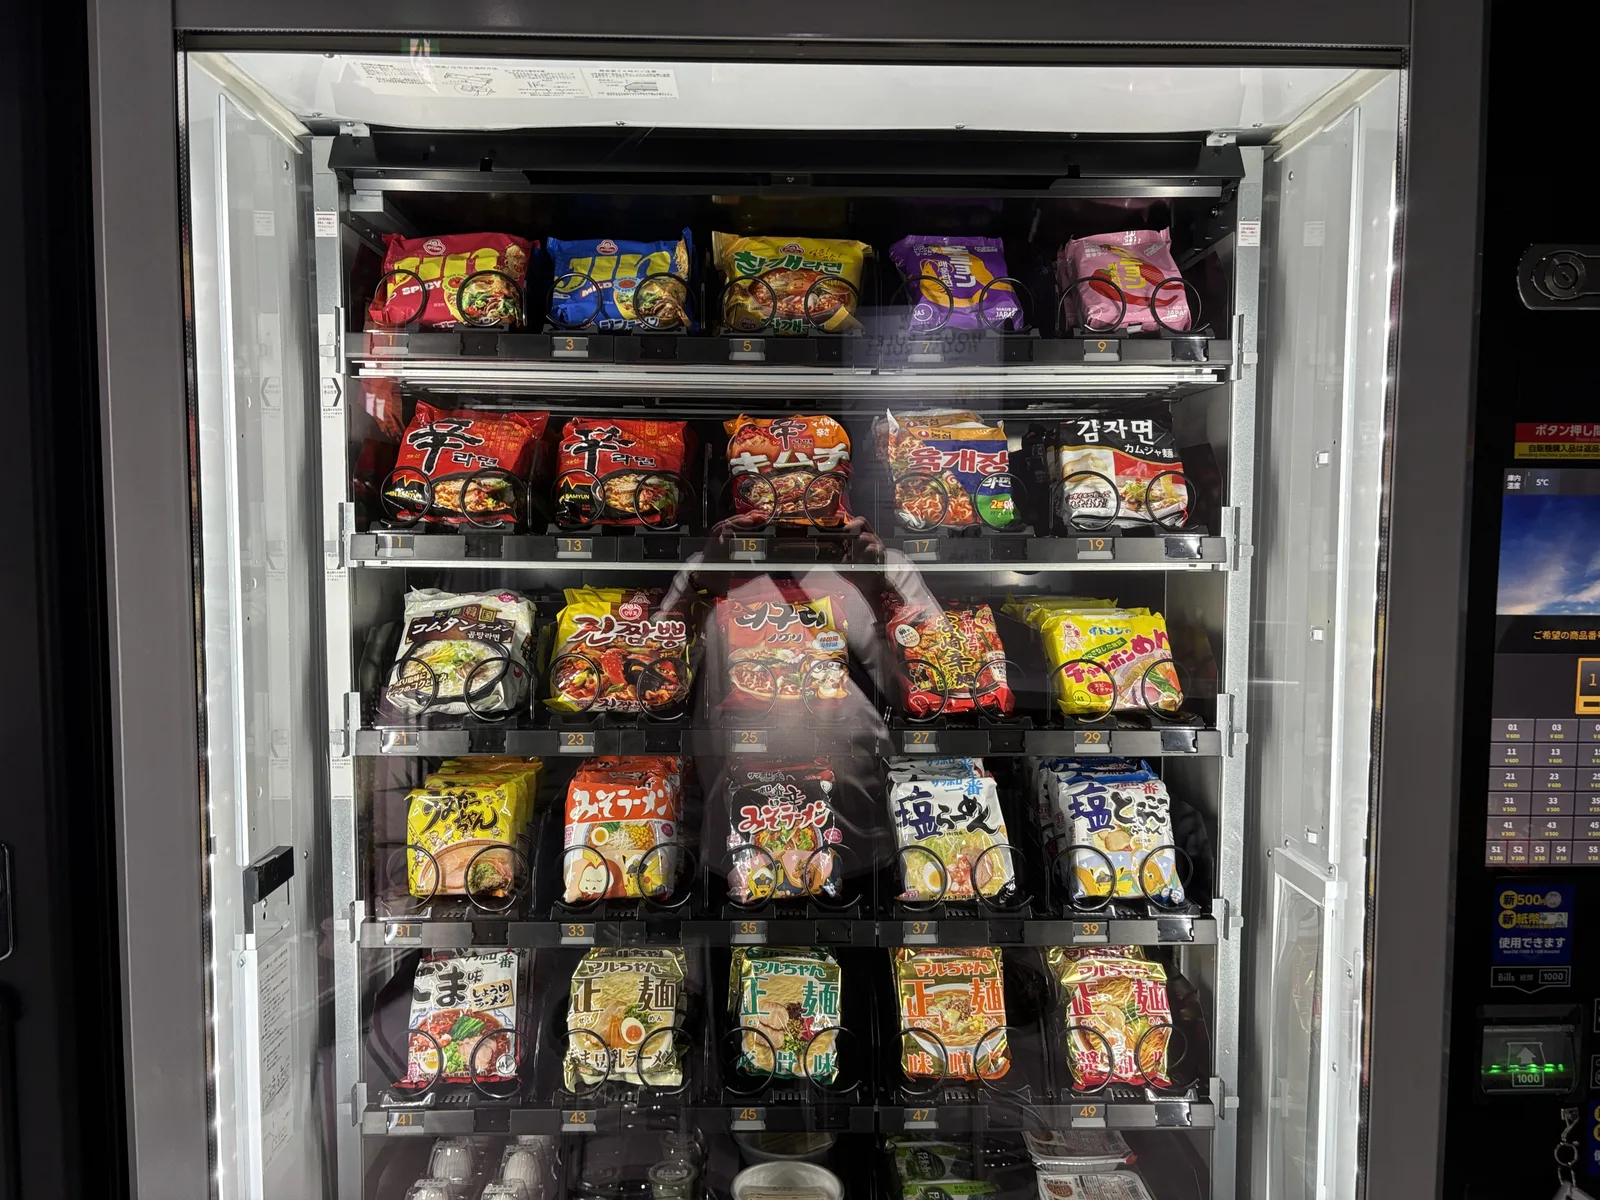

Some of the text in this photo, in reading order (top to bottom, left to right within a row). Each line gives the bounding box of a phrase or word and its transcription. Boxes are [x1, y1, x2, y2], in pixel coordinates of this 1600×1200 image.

[734, 250, 844, 276] 참깨라면
[402, 280, 442, 295] SPICY
[566, 338, 575, 350] 3
[743, 340, 752, 351] 5
[923, 342, 930, 353] 7
[1097, 341, 1107, 352] 9
[769, 419, 807, 450] 辛
[1077, 419, 1154, 445] 감자면
[407, 418, 485, 476] 辛
[563, 426, 636, 477] 辛
[451, 452, 499, 469] 라면
[611, 453, 656, 467] 라면
[730, 443, 850, 476] キムチ
[908, 446, 1010, 476] 육개장
[567, 540, 582, 551] 13
[742, 540, 757, 551] 15
[915, 541, 929, 552] 17
[1089, 539, 1105, 550] 19
[735, 602, 828, 632] 너구리
[567, 615, 687, 649] 진짬뽕
[567, 734, 584, 746] 23
[741, 732, 758, 744] 25
[913, 732, 929, 744] 27
[1084, 732, 1101, 744] 29
[569, 789, 668, 821] みそラーメン
[738, 801, 831, 833] みそラーメン
[568, 925, 585, 937] 33
[740, 922, 757, 934] 35
[912, 922, 929, 934] 37
[1082, 923, 1099, 935] 39
[1499, 937, 1566, 949] 使用できます
[586, 961, 663, 974] マルちゃん
[753, 961, 826, 977] マルちゃん
[914, 961, 991, 976] マルちゃん
[1498, 973, 1515, 982] Bills
[1543, 973, 1564, 981] 1000
[472, 983, 510, 999] しょうゆ
[572, 976, 678, 1014] 正 麺
[474, 995, 508, 1008] ラーメン
[741, 976, 839, 1019] 正 麺
[902, 977, 1005, 1019] 正 麺
[1070, 979, 1171, 1017] 正 麺
[1517, 1074, 1540, 1084] 1000
[569, 1112, 587, 1124] 43
[740, 1108, 757, 1120] 45
[913, 1110, 929, 1121] 47
[1080, 1106, 1097, 1118] 49
[398, 1113, 413, 1125] 41
